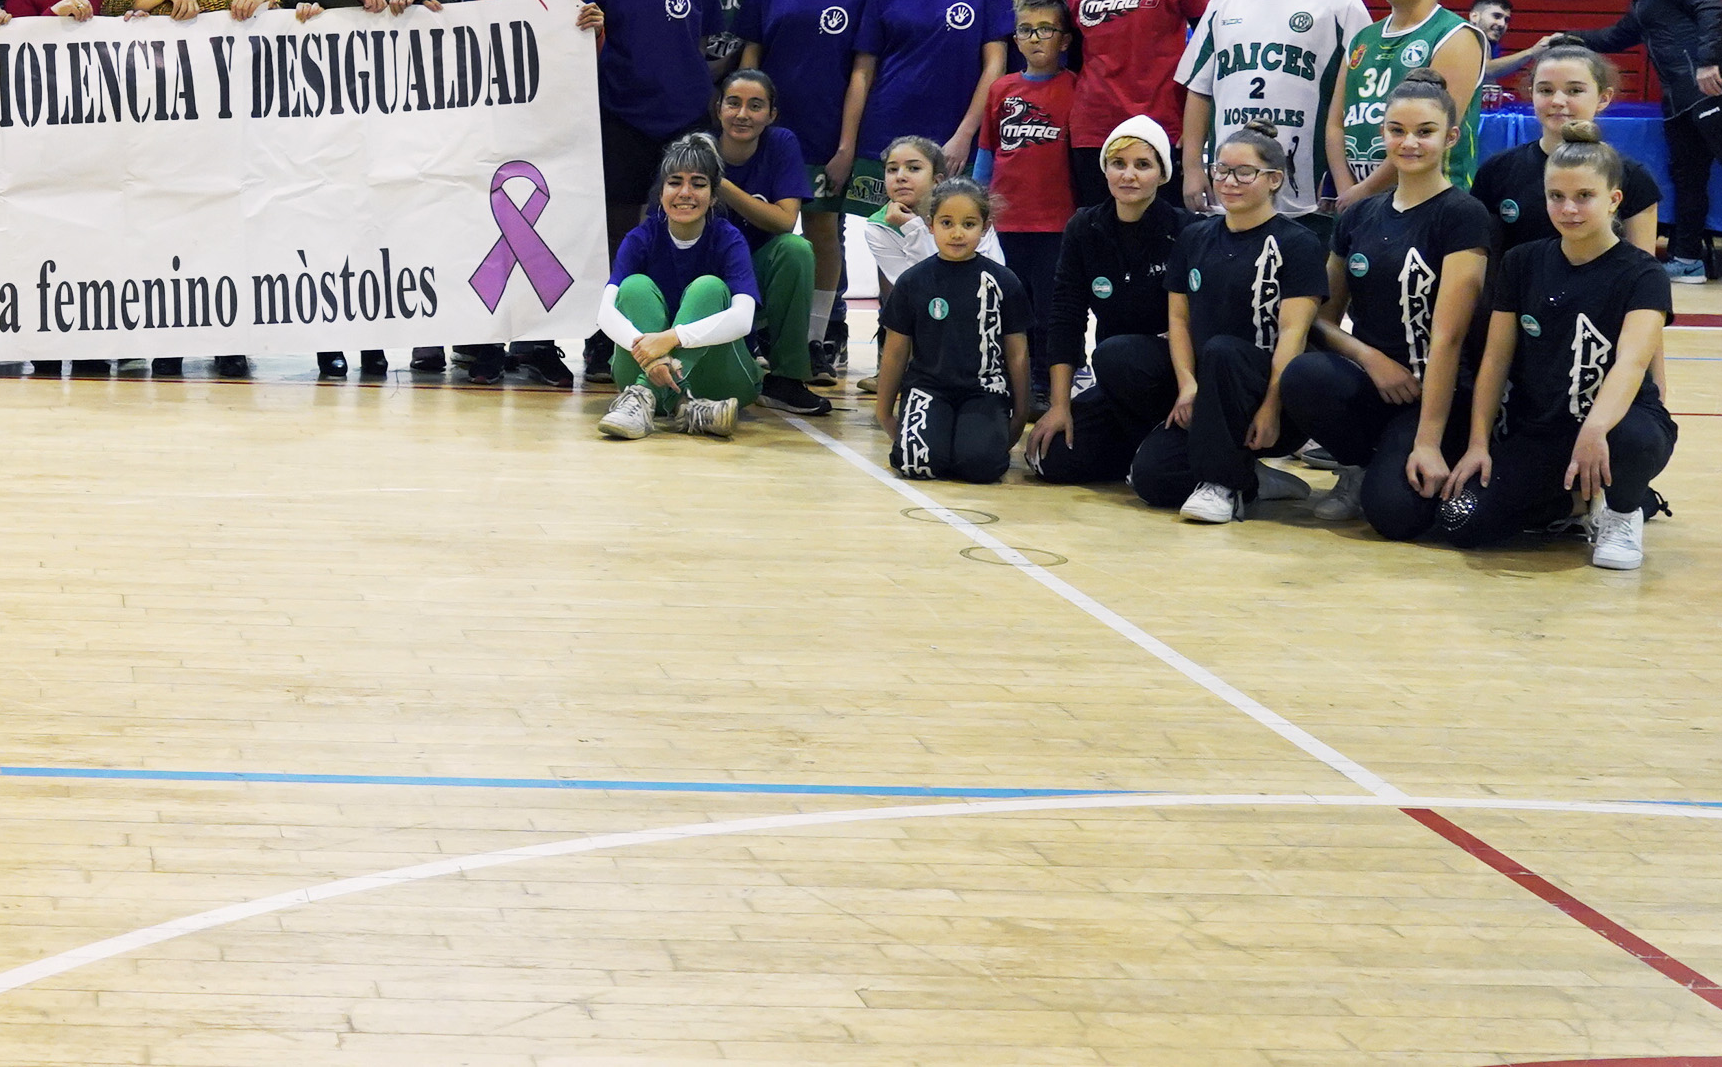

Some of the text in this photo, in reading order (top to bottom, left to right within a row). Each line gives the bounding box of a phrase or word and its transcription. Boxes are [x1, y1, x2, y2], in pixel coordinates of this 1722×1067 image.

[209, 35, 234, 119] Y
[248, 20, 540, 120] DESIGUALDAD
[1217, 42, 1317, 81] RAICES
[1249, 76, 1267, 100] 2
[1358, 67, 1392, 98] 30
[1343, 102, 1386, 128] AIC
[1147, 262, 1167, 276] ADA
[36, 256, 238, 333] femenino
[252, 248, 438, 327] mòstoles
